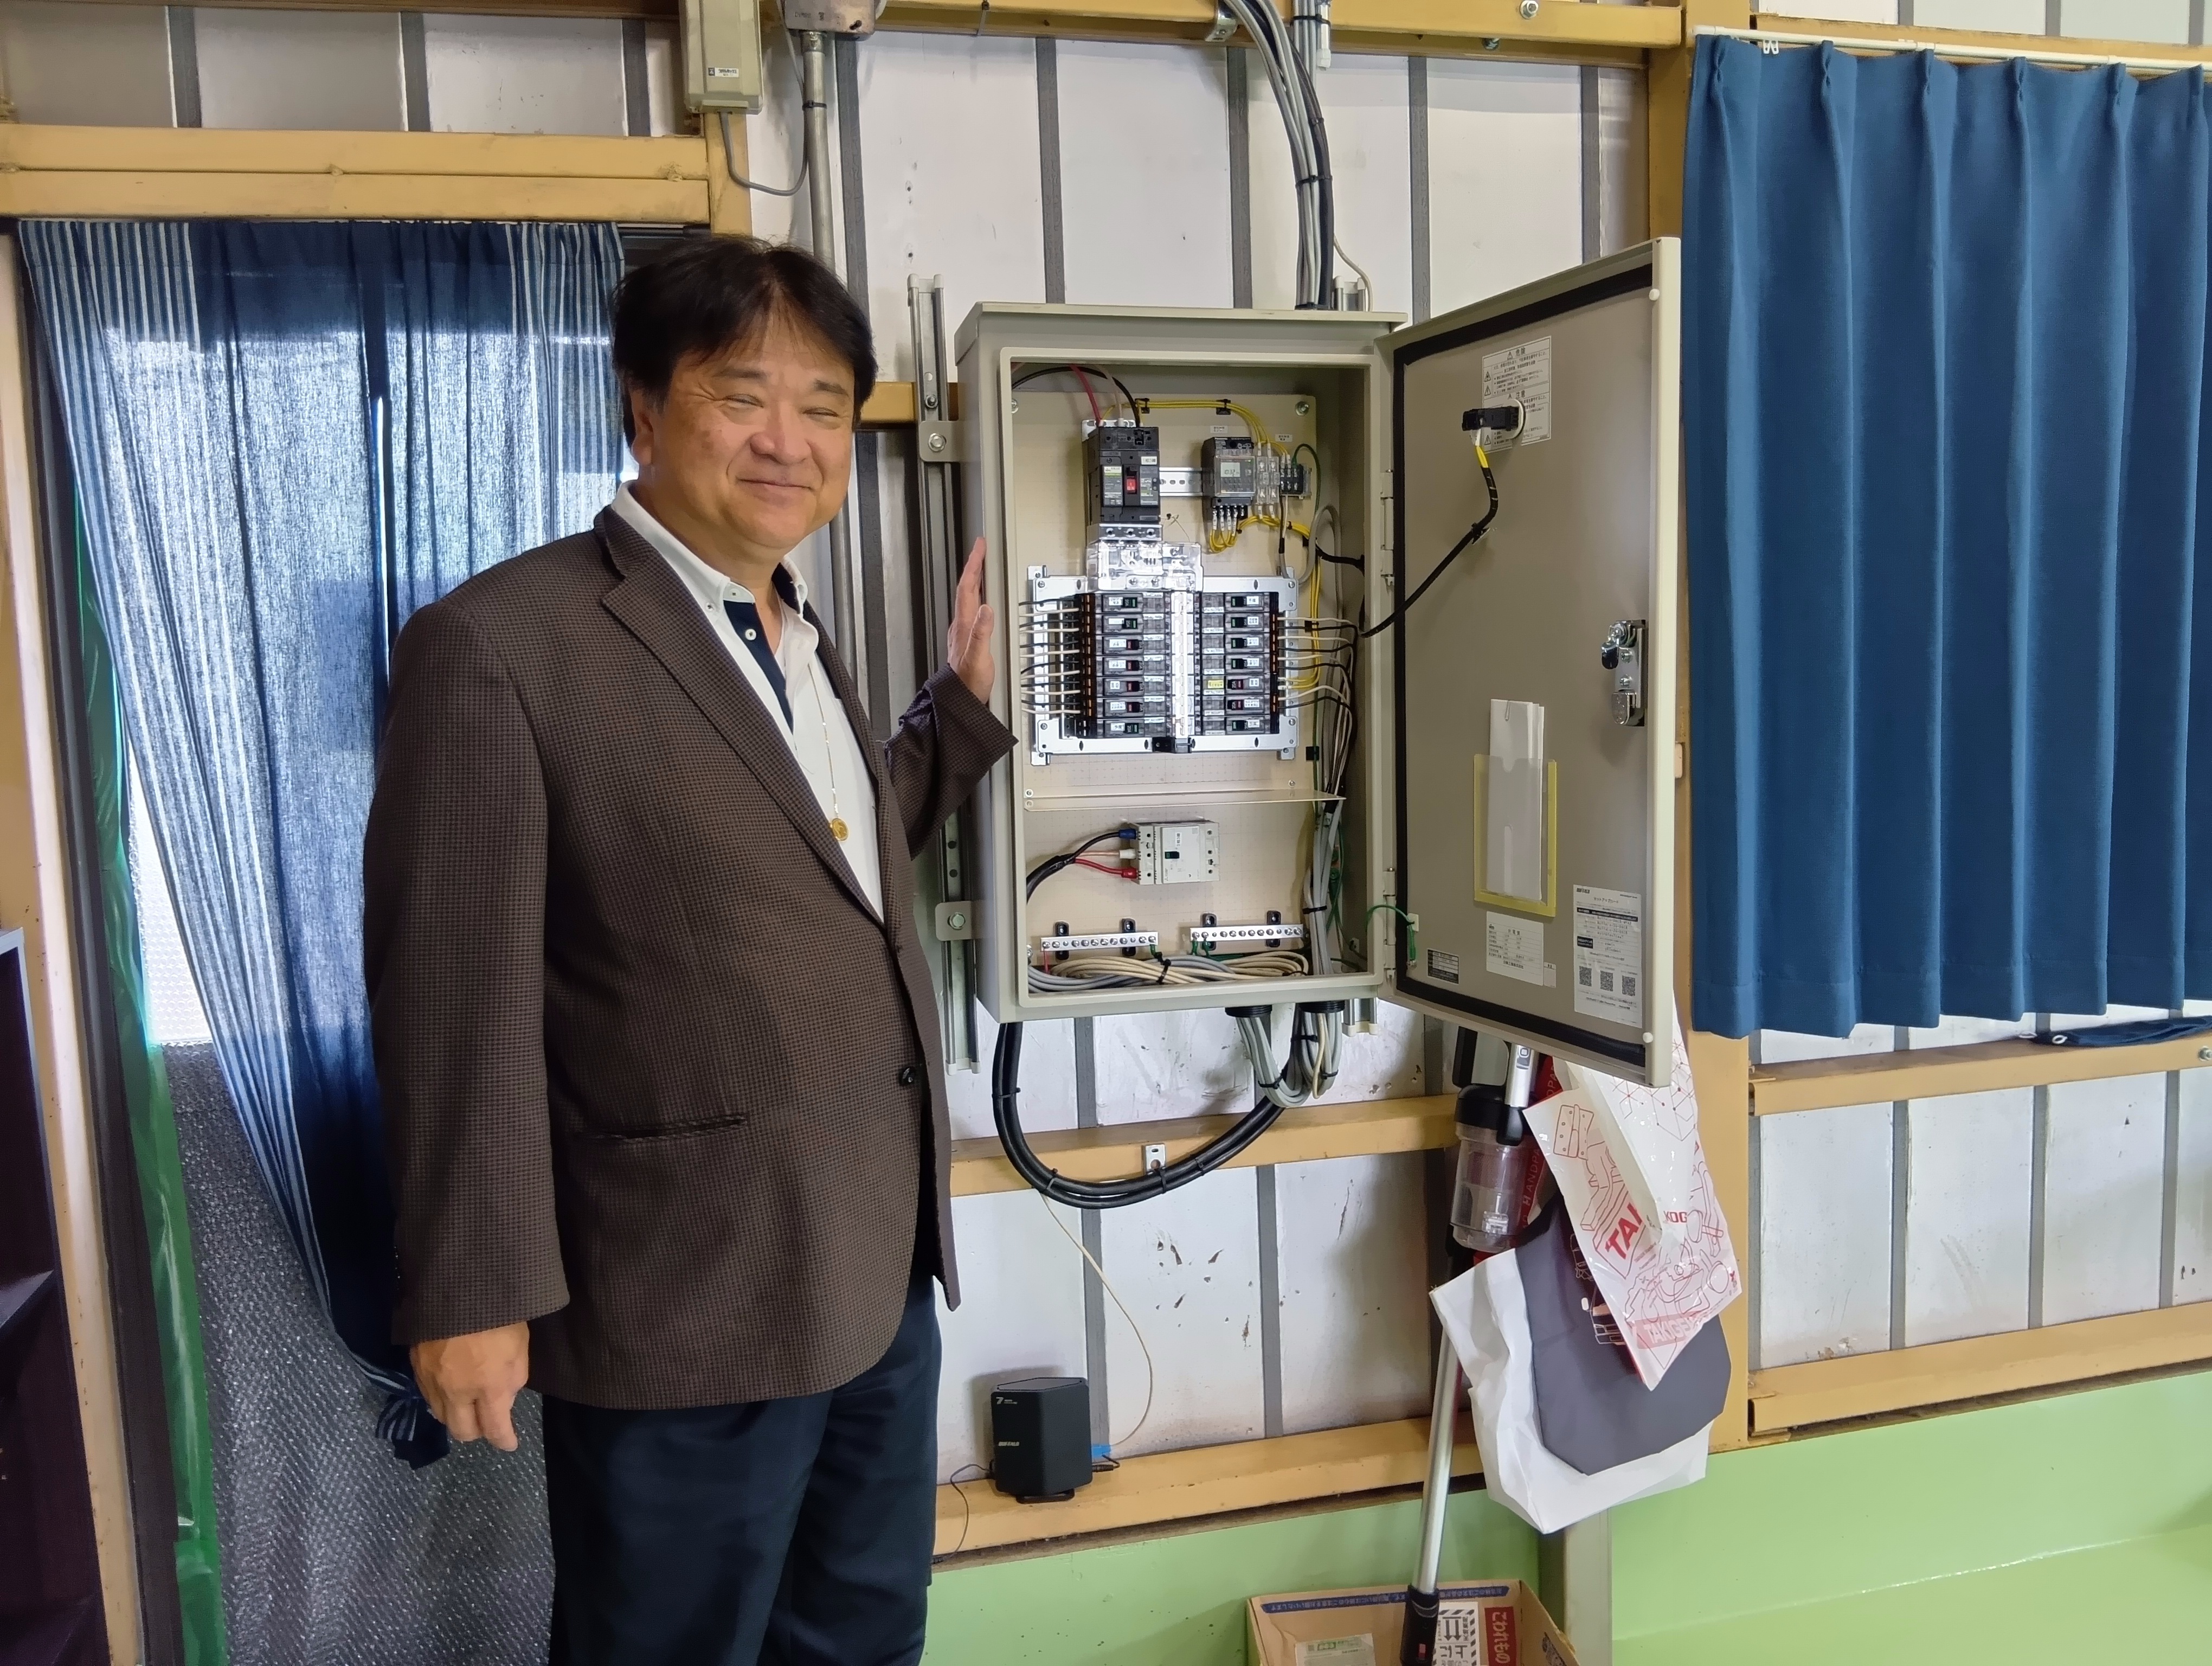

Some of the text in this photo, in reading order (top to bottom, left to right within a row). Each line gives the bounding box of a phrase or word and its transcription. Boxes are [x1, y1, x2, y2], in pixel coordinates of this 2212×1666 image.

[1439, 1645, 1468, 1659] 上に
[1492, 1611, 1511, 1664] こわれもの
